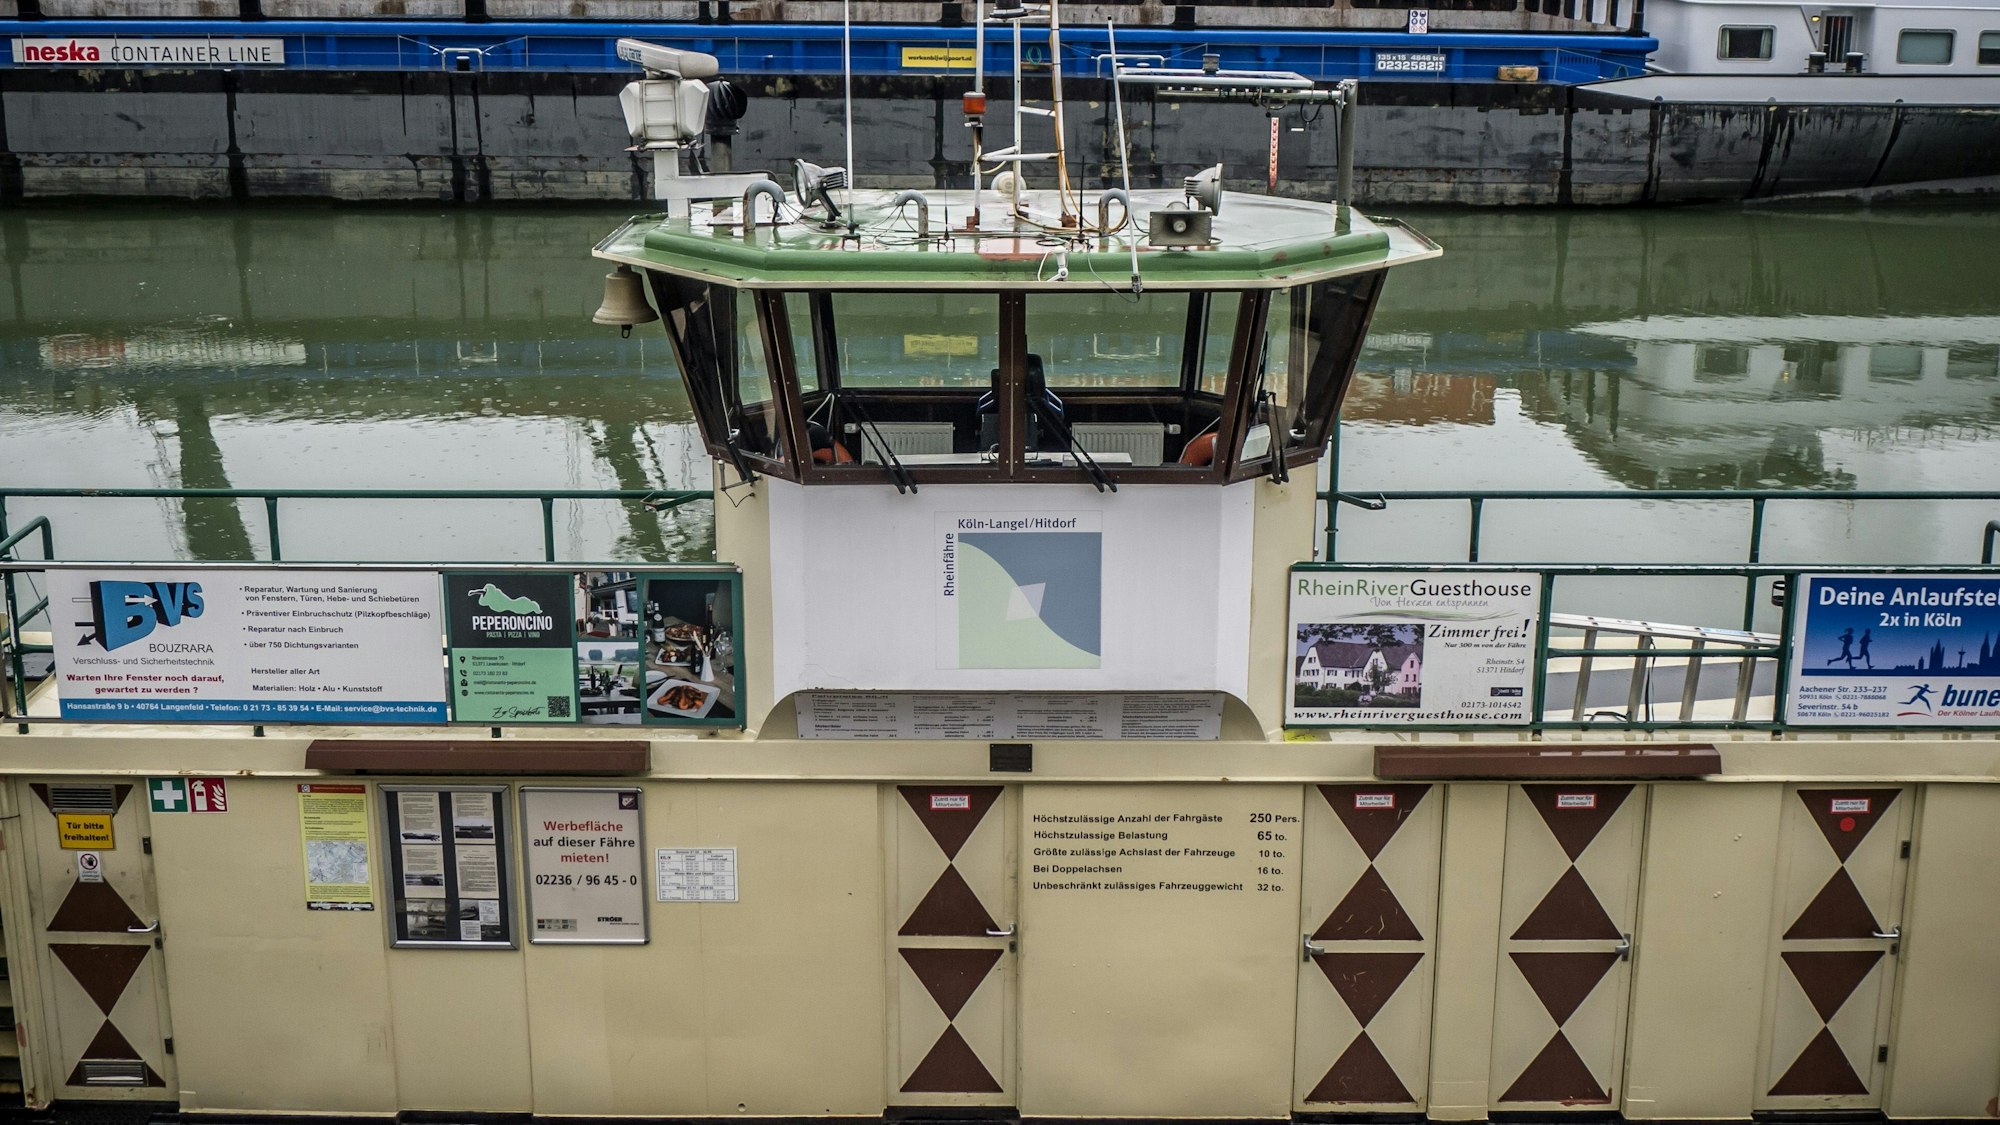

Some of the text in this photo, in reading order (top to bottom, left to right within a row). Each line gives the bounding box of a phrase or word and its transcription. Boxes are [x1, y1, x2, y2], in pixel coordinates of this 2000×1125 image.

[25, 40, 272, 62] neska CONTAINER LINE
[1377, 60, 1443, 71] 02325825
[958, 518, 1077, 530] Köln-Langel/Hitdorf
[943, 533, 954, 596] Rheinfähre
[286, 586, 318, 594] Wartung
[1298, 579, 1532, 596] RheinRiverGuesthouse
[1819, 586, 1885, 606] Deine
[1370, 596, 1489, 609] Von Herzen entspannen
[89, 580, 205, 652] BVS
[355, 610, 430, 619] (Pilzkopfbeschläge)
[1879, 612, 1962, 627] 2x in Köln
[472, 616, 553, 630] PEPERONCINO
[1428, 624, 1490, 638] Zimmer
[149, 644, 214, 653] BOUZRARA
[73, 657, 120, 665] Verschluss-
[140, 658, 215, 666] Sicherheitstechnik
[1477, 666, 1525, 674] 51371 Hitdorf
[66, 674, 102, 682] Warten
[104, 674, 123, 682] Ihre
[126, 674, 162, 682] Fenster
[191, 675, 224, 683] darauf,
[94, 687, 138, 695] gewartet
[67, 702, 116, 710] Hansastraße
[160, 704, 204, 712] Langenfeld
[1294, 710, 1522, 721] www.rheinriverguesthouse.com
[1033, 813, 1300, 824] Höchstzulässige Anzahl der Fahrgäste 250 Pers.
[543, 821, 623, 832] Werbefläche
[64, 834, 109, 842] freihalten!
[1118, 832, 1168, 840] Belastung
[1257, 831, 1272, 840] 65
[533, 837, 635, 848] auf dieser Fähre
[561, 853, 609, 863] mieten!
[1034, 848, 1285, 858] Größte zulässige Achslast der Fahrzeuge 10 to.
[1052, 865, 1122, 874] Doppelachsen
[536, 874, 572, 885] 02236
[586, 875, 600, 885] 96
[604, 875, 619, 885] 45
[630, 875, 637, 885] 0
[1033, 882, 1101, 890] Unbeschränkt
[1104, 882, 1156, 891] zulässiges
[1159, 882, 1243, 892] Fahrzeuggewicht
